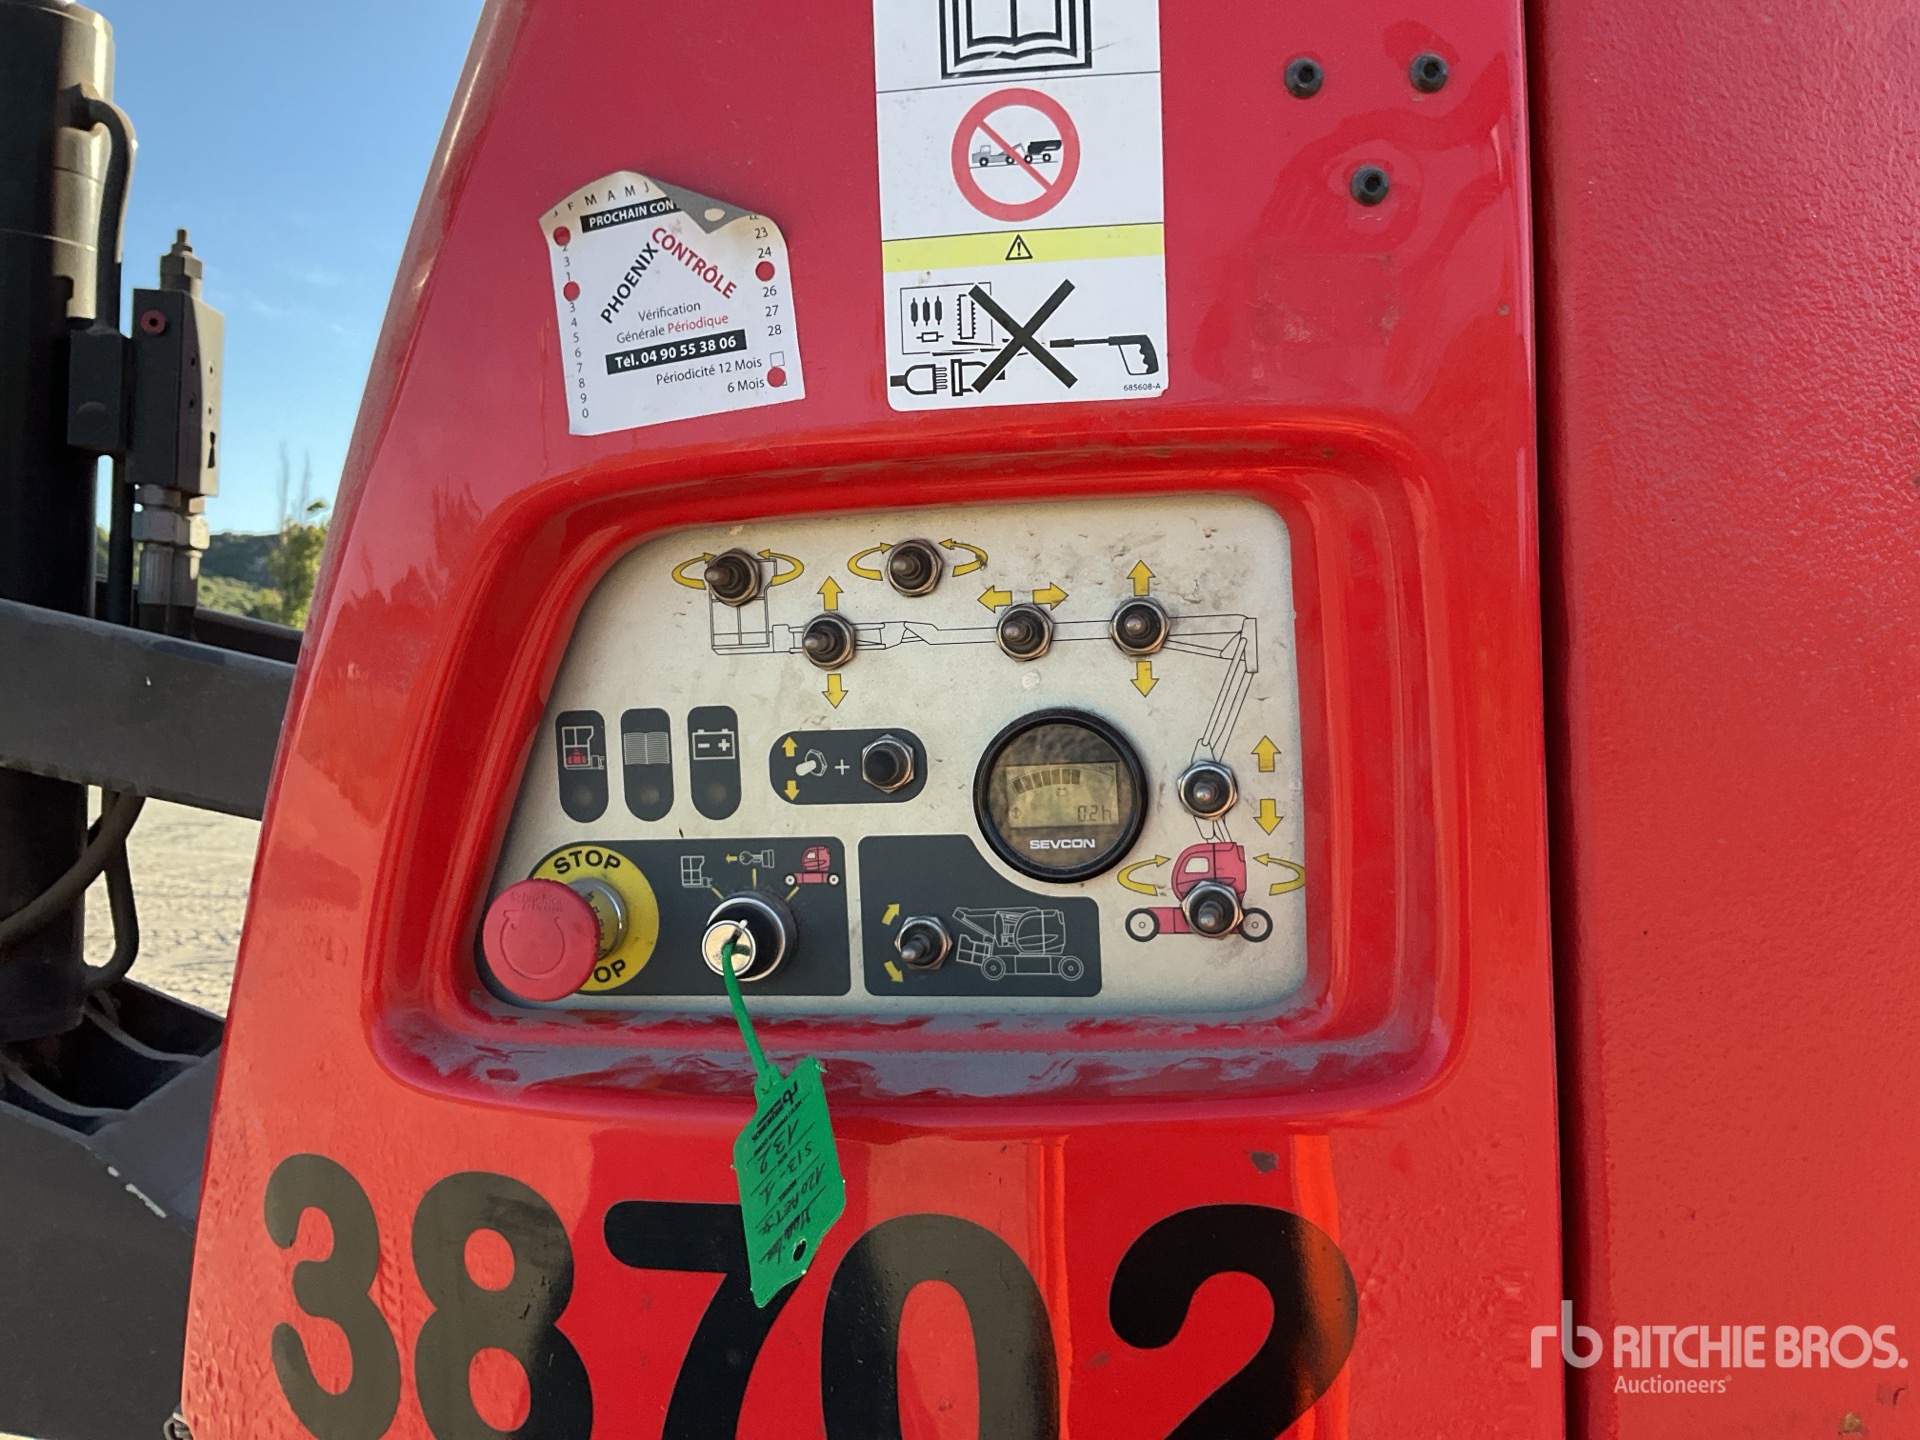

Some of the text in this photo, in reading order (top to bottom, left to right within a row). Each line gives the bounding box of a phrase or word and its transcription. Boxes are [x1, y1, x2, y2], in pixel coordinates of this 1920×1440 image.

[567, 202, 574, 211] F
[584, 194, 598, 206] M
[607, 190, 616, 202] A
[624, 185, 636, 197] M
[645, 182, 650, 193] J
[588, 199, 679, 228] PROCHAIN CON
[754, 226, 769, 239] 23
[757, 246, 772, 259] 24
[564, 256, 571, 267] 3
[651, 227, 737, 299] CONTRÔLE
[600, 242, 659, 324] PHOENIX
[762, 285, 777, 298] 26
[570, 302, 576, 313] 3
[637, 302, 701, 322] Vérification
[765, 304, 779, 317] 27
[571, 317, 578, 327] 4
[616, 314, 729, 344] Générale Périodique
[767, 324, 782, 337] 28
[573, 332, 579, 343] 5
[574, 348, 581, 358] 6
[614, 335, 737, 369] Tél. 04 90 55 38 06
[576, 362, 583, 373] 7
[656, 356, 763, 385] Périodicité 12 Mois
[578, 377, 586, 389] 8
[727, 377, 765, 393] 6 Mois
[1123, 382, 1162, 392] 685608-A
[580, 392, 587, 404] 9
[582, 408, 589, 419] 0
[1029, 838, 1096, 849] SEVCON
[553, 849, 621, 874] STOP
[264, 1153, 1358, 1440] 38702
